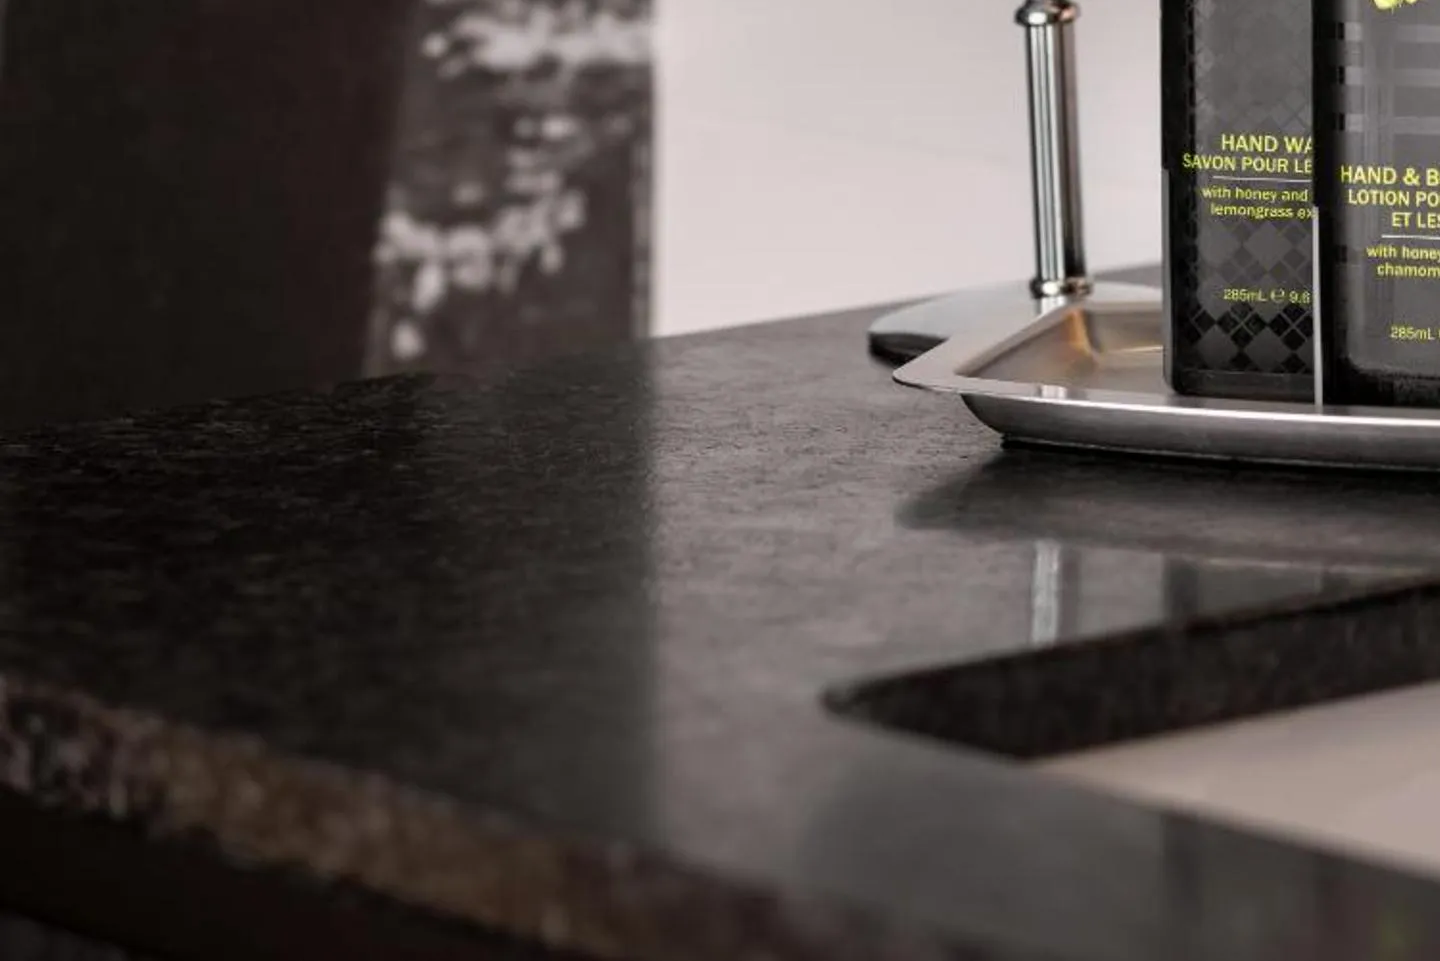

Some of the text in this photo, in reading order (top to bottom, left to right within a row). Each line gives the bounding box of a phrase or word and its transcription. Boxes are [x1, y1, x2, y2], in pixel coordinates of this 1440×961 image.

[1221, 133, 1278, 152] HAND
[1182, 152, 1236, 171] SAVON
[1241, 155, 1288, 173] POUR
[1341, 166, 1397, 185] HAND
[1403, 168, 1420, 186] &
[1202, 185, 1308, 202] with honey and
[1348, 189, 1409, 206] LOTION
[1211, 202, 1293, 220] lemongrass
[1392, 212, 1412, 228] ET
[1366, 244, 1397, 259] with
[1390, 324, 1436, 340] 285mL
